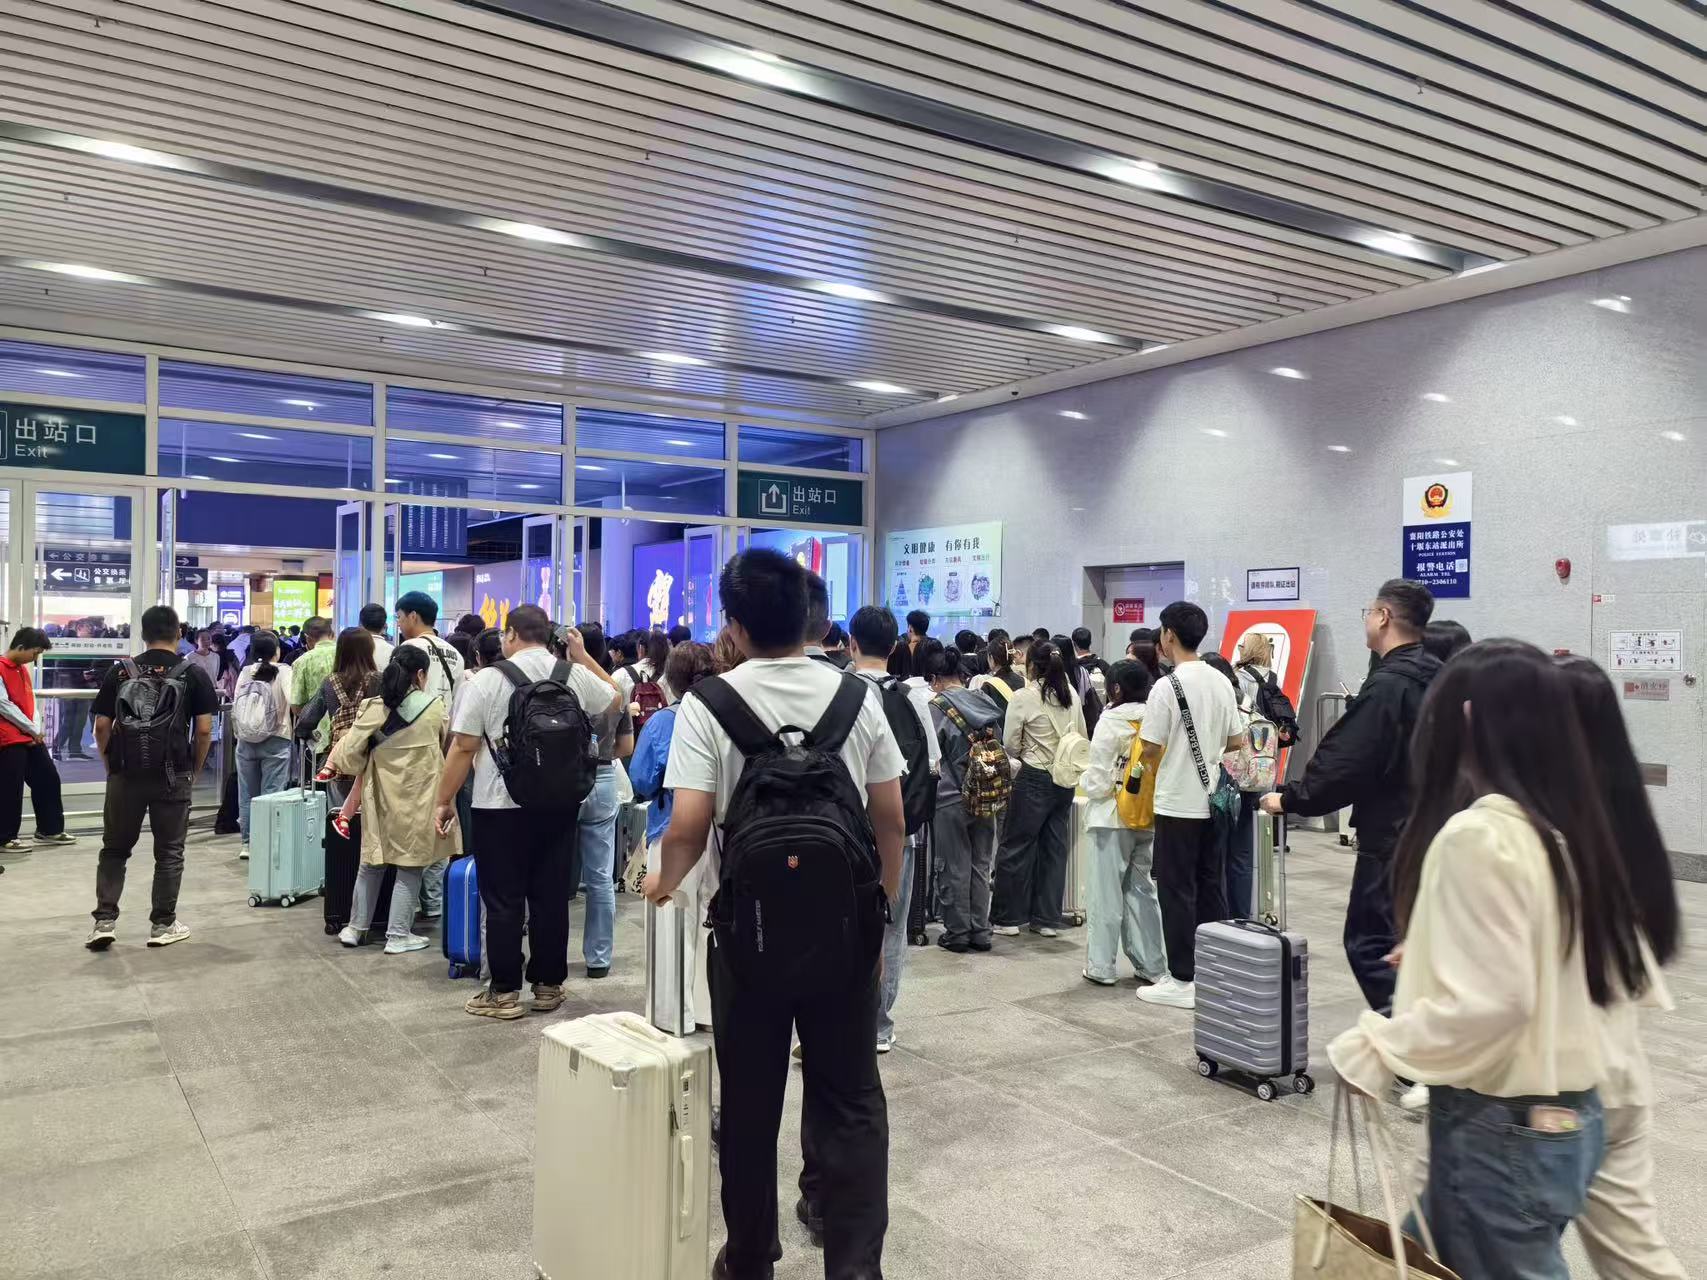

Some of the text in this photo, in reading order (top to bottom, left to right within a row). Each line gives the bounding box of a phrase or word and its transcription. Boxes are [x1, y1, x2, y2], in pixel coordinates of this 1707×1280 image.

[15, 417, 97, 444] 出站口
[15, 444, 49, 458] Exit
[792, 485, 837, 504] 出站口
[792, 504, 811, 515] Exit
[1410, 529, 1464, 540] 襄阳铁路公安处
[904, 537, 980, 555] 文明健康 有你有我
[1411, 540, 1464, 551] 十堰东站派出所
[1416, 561, 1455, 572] 报警电话
